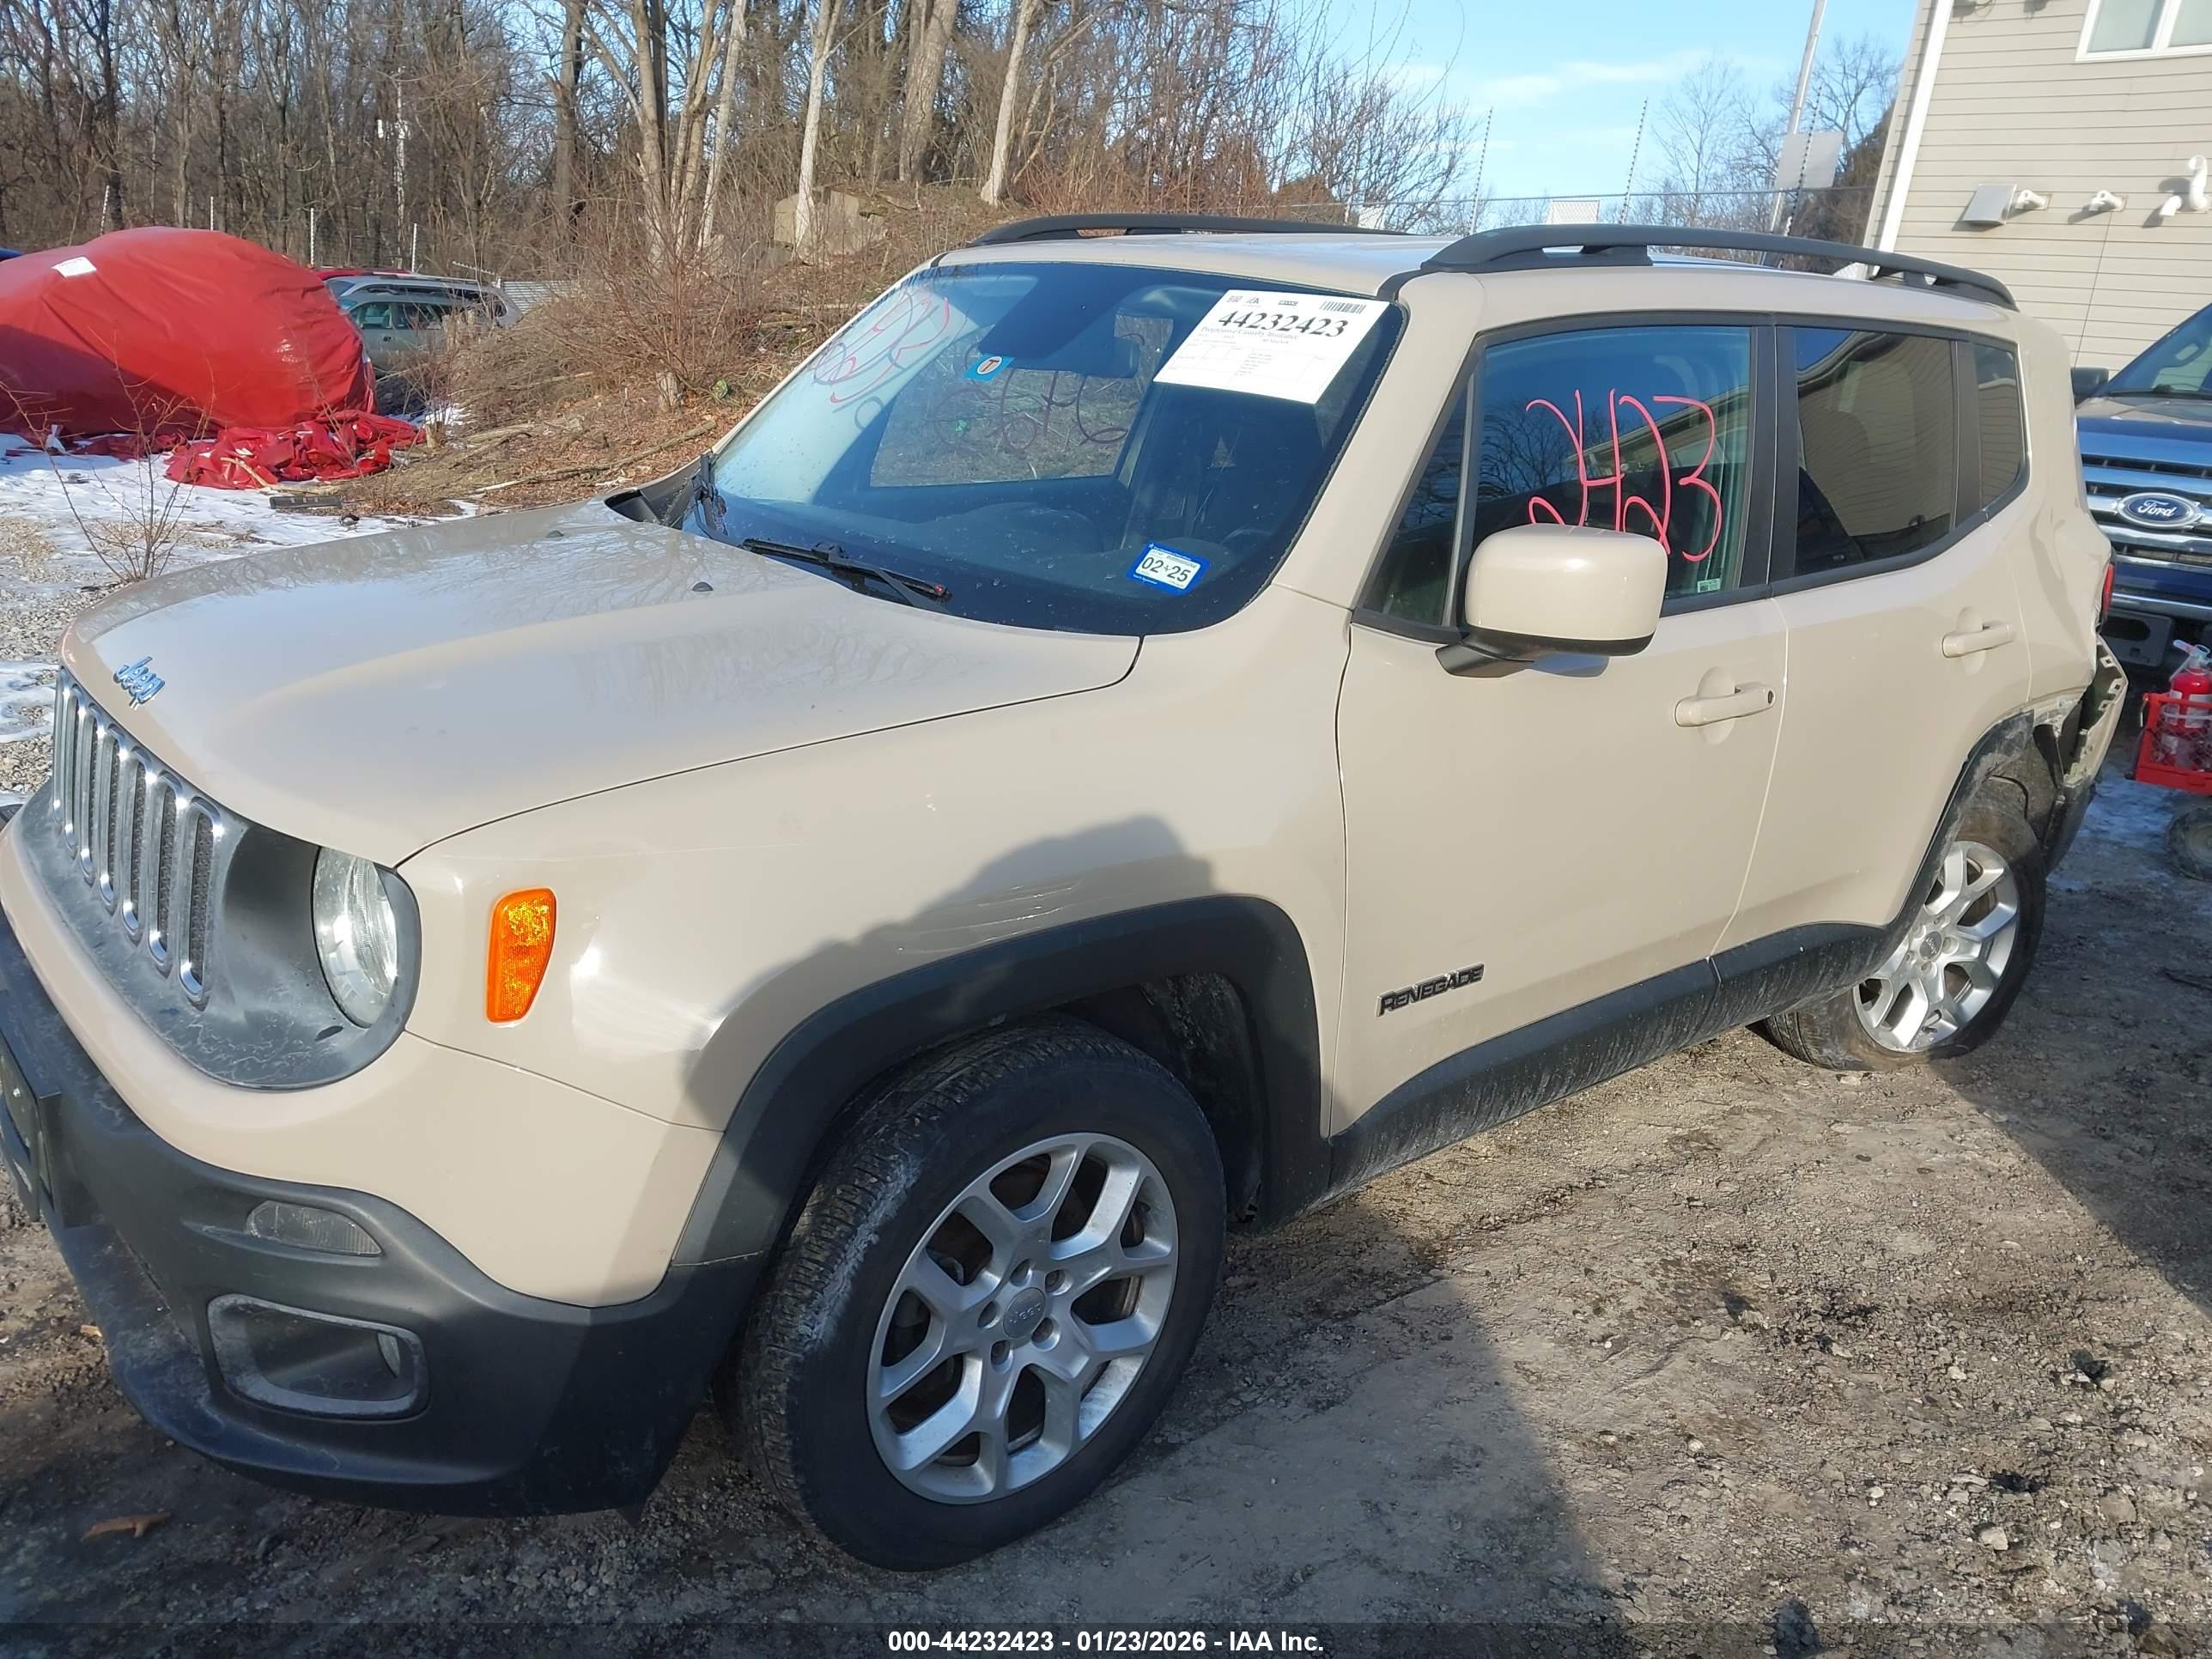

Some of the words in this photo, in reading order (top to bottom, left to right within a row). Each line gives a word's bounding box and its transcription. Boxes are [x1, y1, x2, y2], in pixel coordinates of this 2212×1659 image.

[1218, 310, 1348, 337] 44232423
[2138, 500, 2177, 516] Ford
[1142, 557, 1164, 573] 02
[1168, 566, 1191, 581] 25
[113, 656, 165, 710] Jeep
[1376, 963, 1484, 1017] RENEGADE
